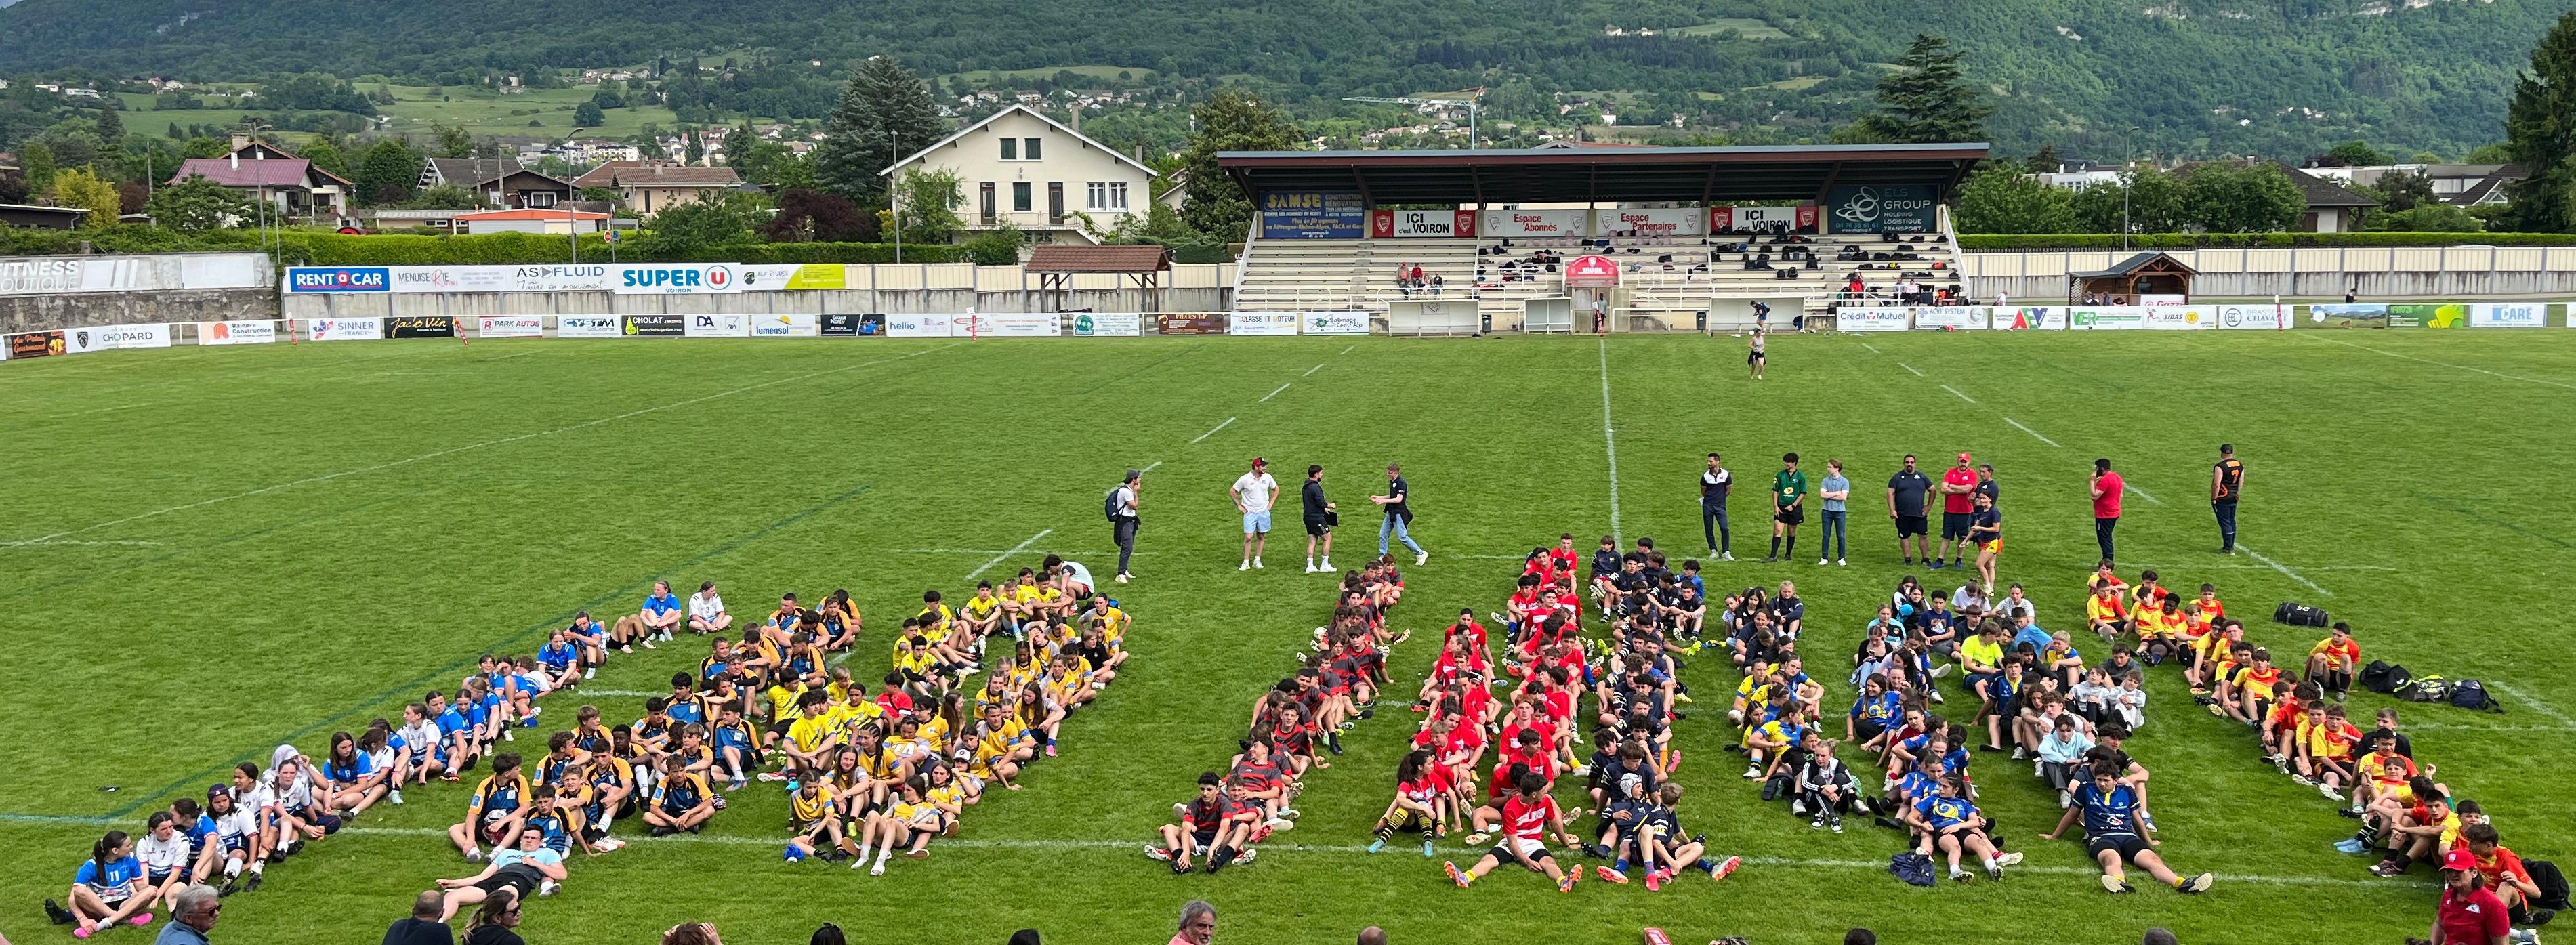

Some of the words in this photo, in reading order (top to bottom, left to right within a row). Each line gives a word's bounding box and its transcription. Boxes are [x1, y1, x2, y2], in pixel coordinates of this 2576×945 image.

[1884, 188, 1909, 197] ELS
[1267, 193, 1321, 209] SAMSE
[1884, 199, 1931, 209] GROUP
[1406, 213, 1424, 224] ICI
[1514, 214, 1541, 224] Espace
[1621, 213, 1649, 223] Espace
[1745, 210, 1764, 221] ICI
[1413, 224, 1449, 234] VOIRON
[1524, 223, 1558, 232] Abonnés
[1632, 222, 1677, 230] Partenaires
[0, 260, 79, 277] ITNESS
[516, 267, 539, 278] AS
[553, 266, 604, 277] FLUID
[296, 273, 335, 285] RENT
[338, 274, 347, 282] a
[351, 272, 383, 285] CAR
[623, 269, 701, 287] SUPER
[711, 272, 725, 285] U
[561, 280, 605, 290] mouvement
[1840, 312, 1866, 320] Crédit
[1876, 312, 1905, 320] Mutuel
[337, 322, 374, 330] SINNER
[425, 316, 447, 327] Vin
[697, 316, 715, 327] DA
[890, 322, 915, 330] hellio
[756, 325, 789, 335] lumensol
[103, 332, 153, 342] CHOPARD
[2231, 469, 2239, 484] 7
[161, 850, 167, 860] 7
[110, 870, 120, 883] 11
